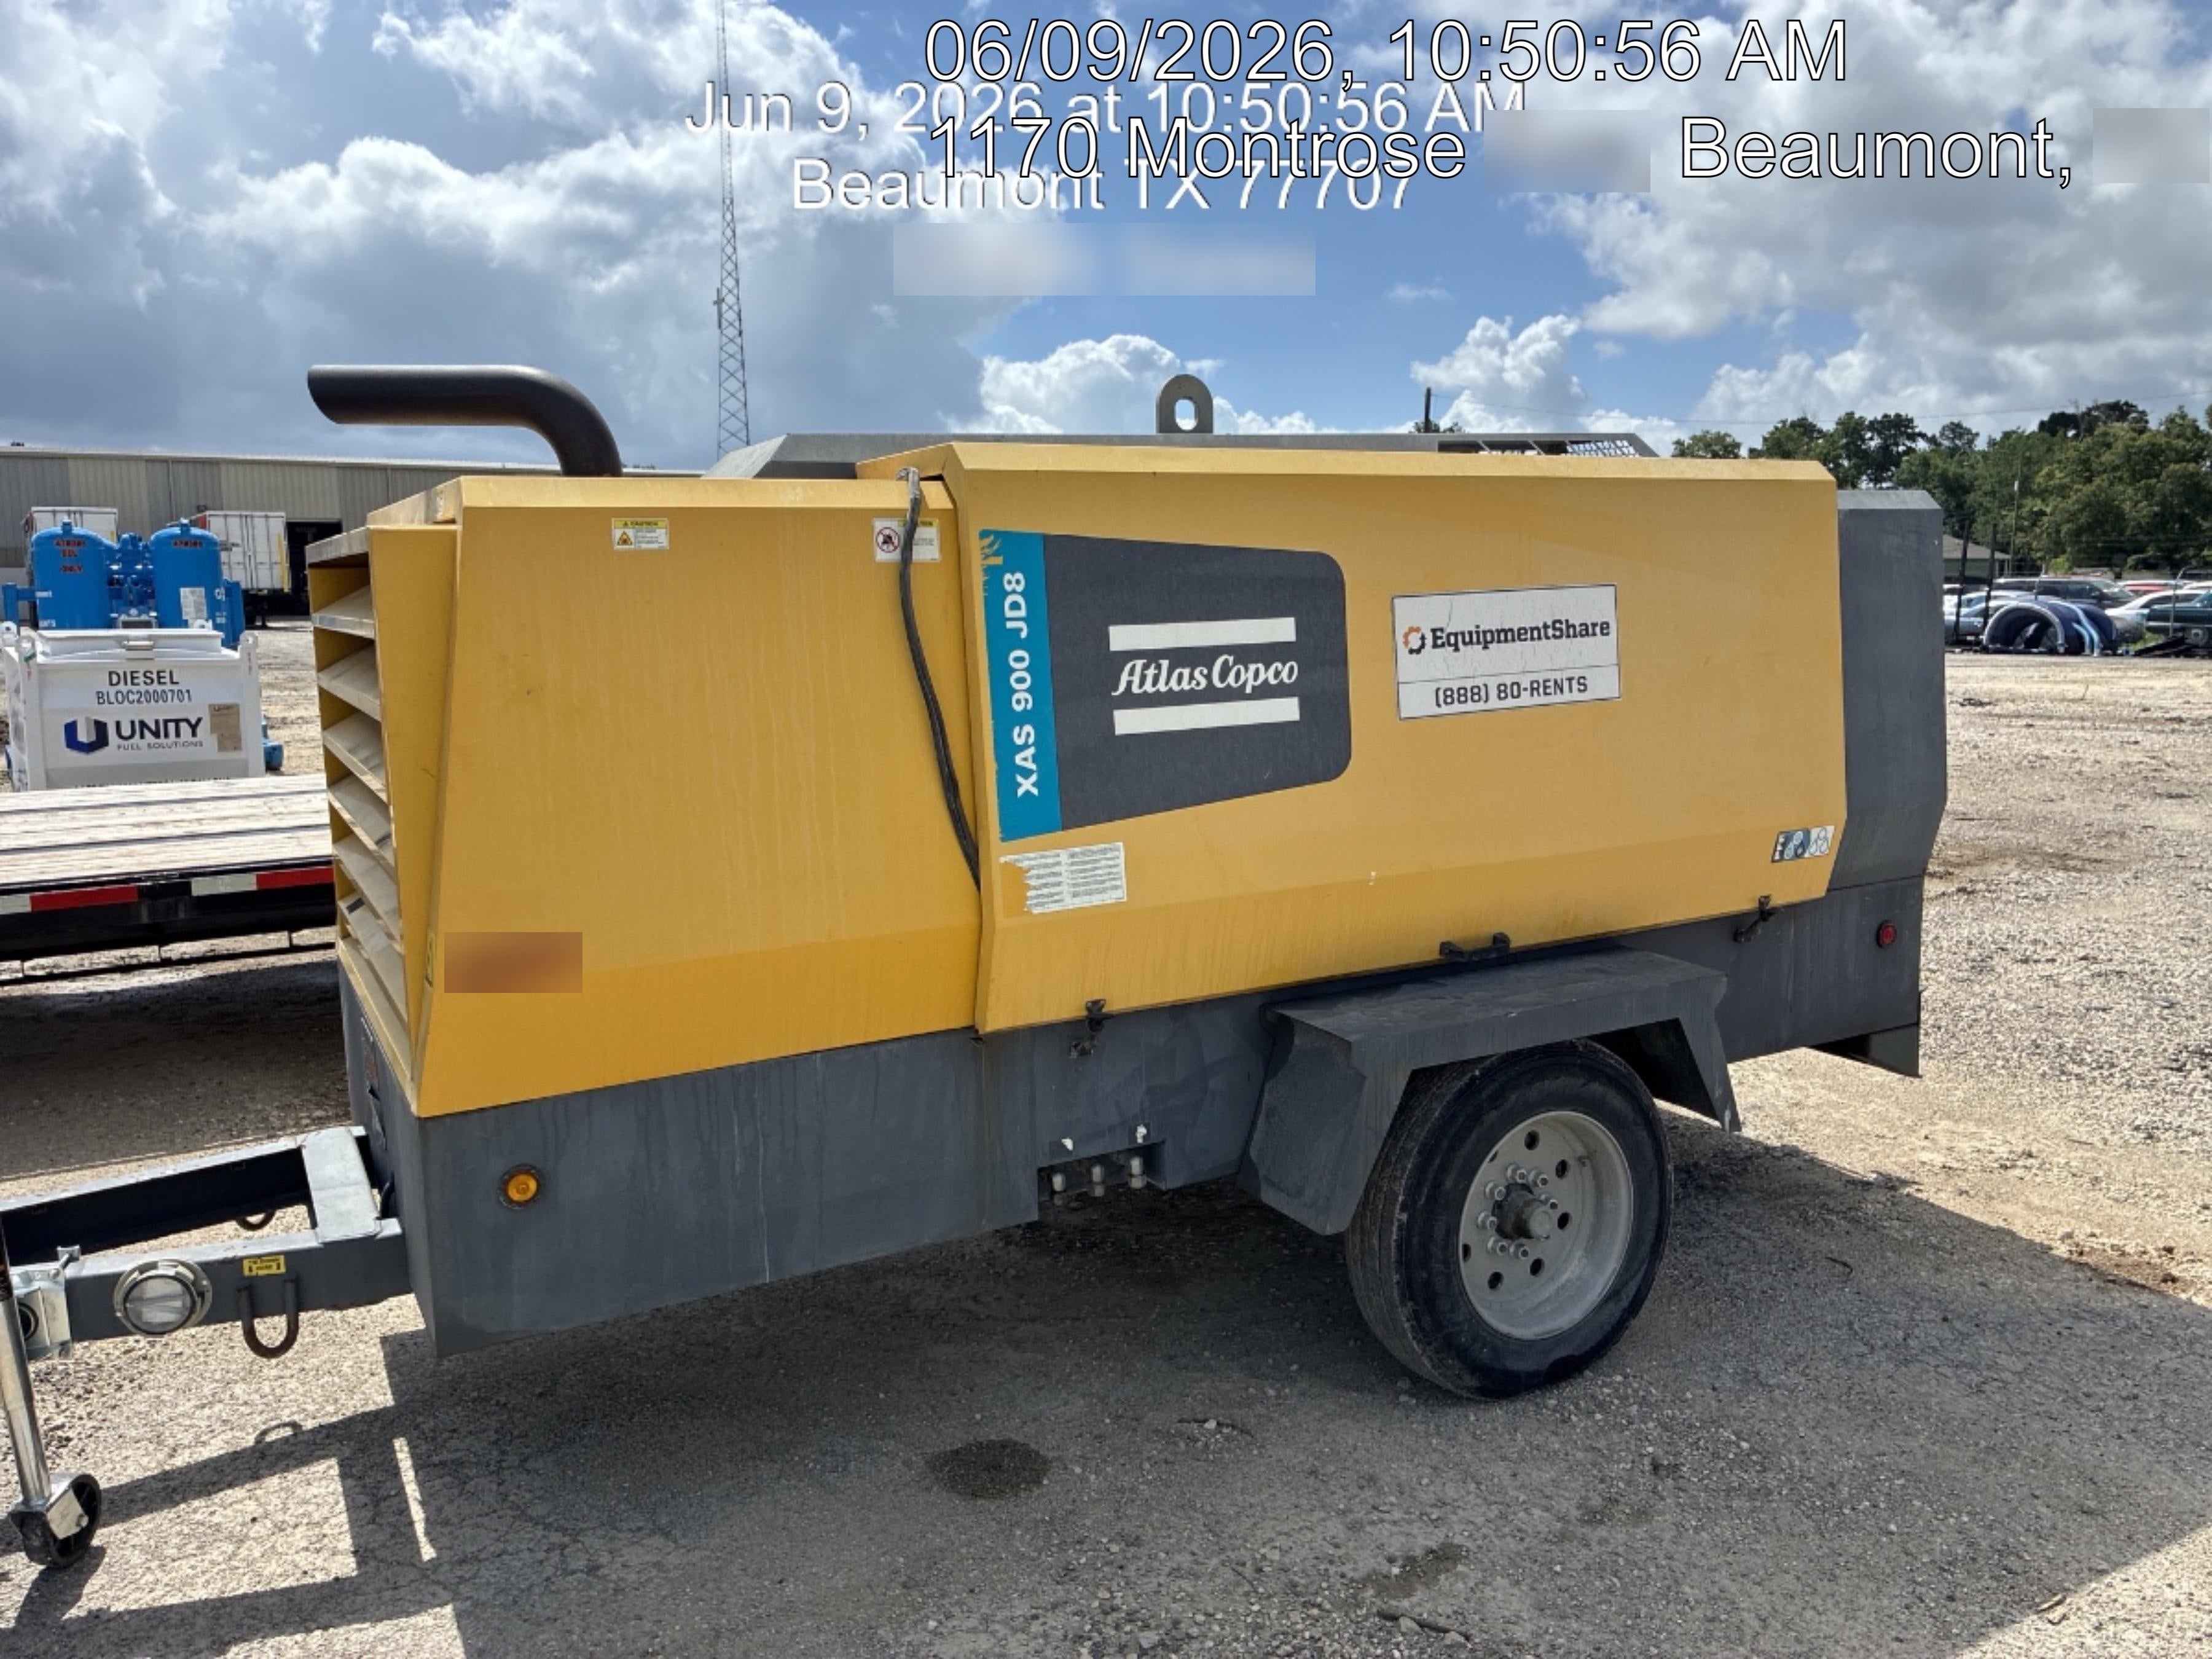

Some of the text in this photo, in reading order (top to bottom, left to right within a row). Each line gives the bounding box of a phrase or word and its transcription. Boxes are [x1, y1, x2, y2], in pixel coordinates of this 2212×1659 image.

[1430, 618, 1610, 653] EquipmentShare
[108, 669, 179, 687] DIESEL
[1003, 571, 1039, 798] XAS 900 JD8
[1111, 654, 1299, 696] Atlas Copco
[95, 689, 192, 705] BLOC2000701
[1435, 675, 1588, 708] (888) 80-RENTS
[115, 717, 203, 741] UNITY
[117, 740, 203, 751] FUEL SOLUTIONS
